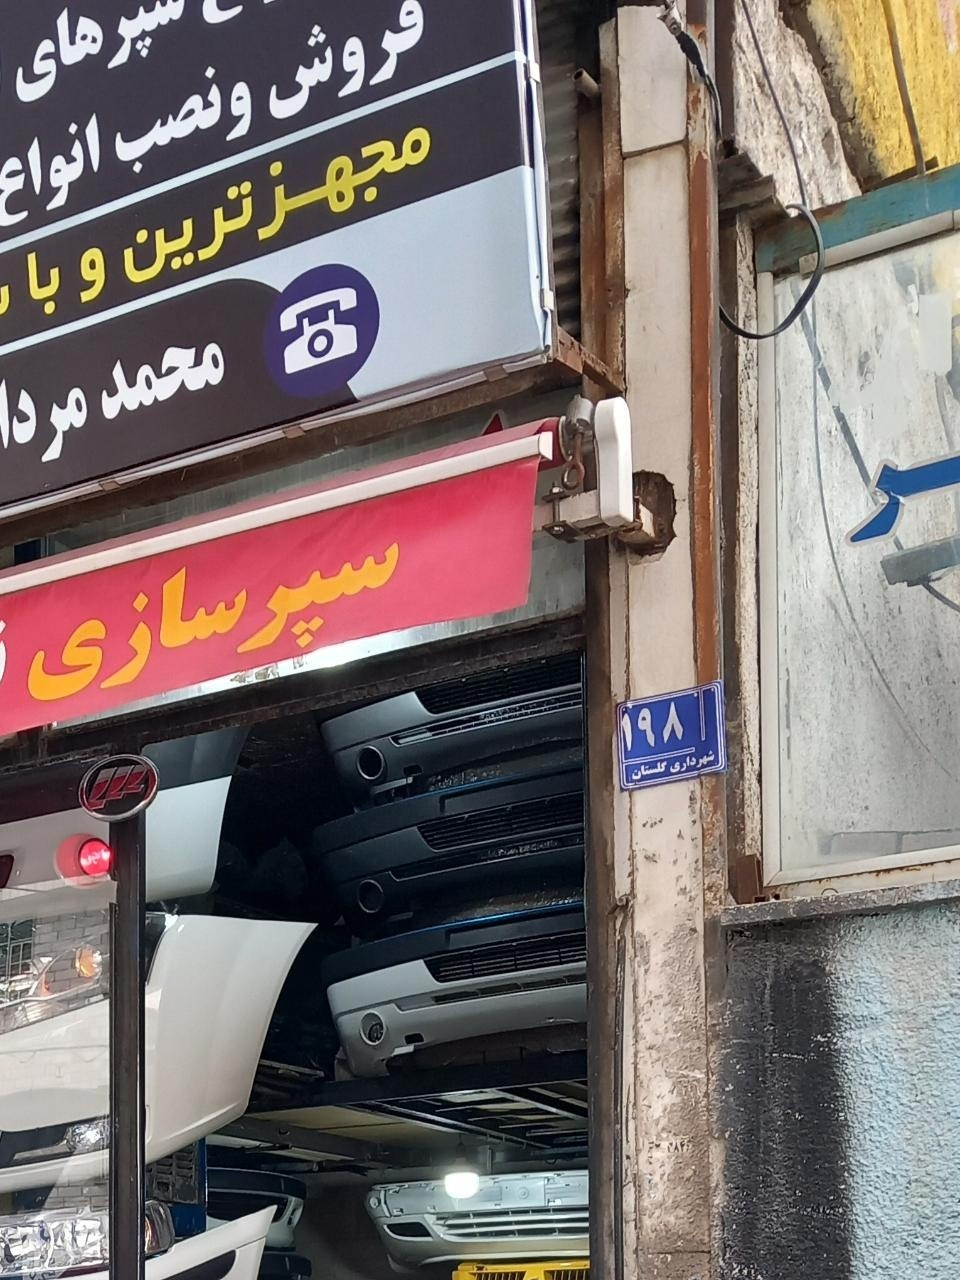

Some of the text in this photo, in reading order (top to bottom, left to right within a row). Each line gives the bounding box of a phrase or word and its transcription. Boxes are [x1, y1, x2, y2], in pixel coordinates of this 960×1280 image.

[27, 253, 61, 315] با
[80, 249, 106, 302] و
[101, 343, 225, 420] محمد
[622, 701, 685, 752] ۱۹۸
[631, 750, 715, 780] شهرداری گلستان
